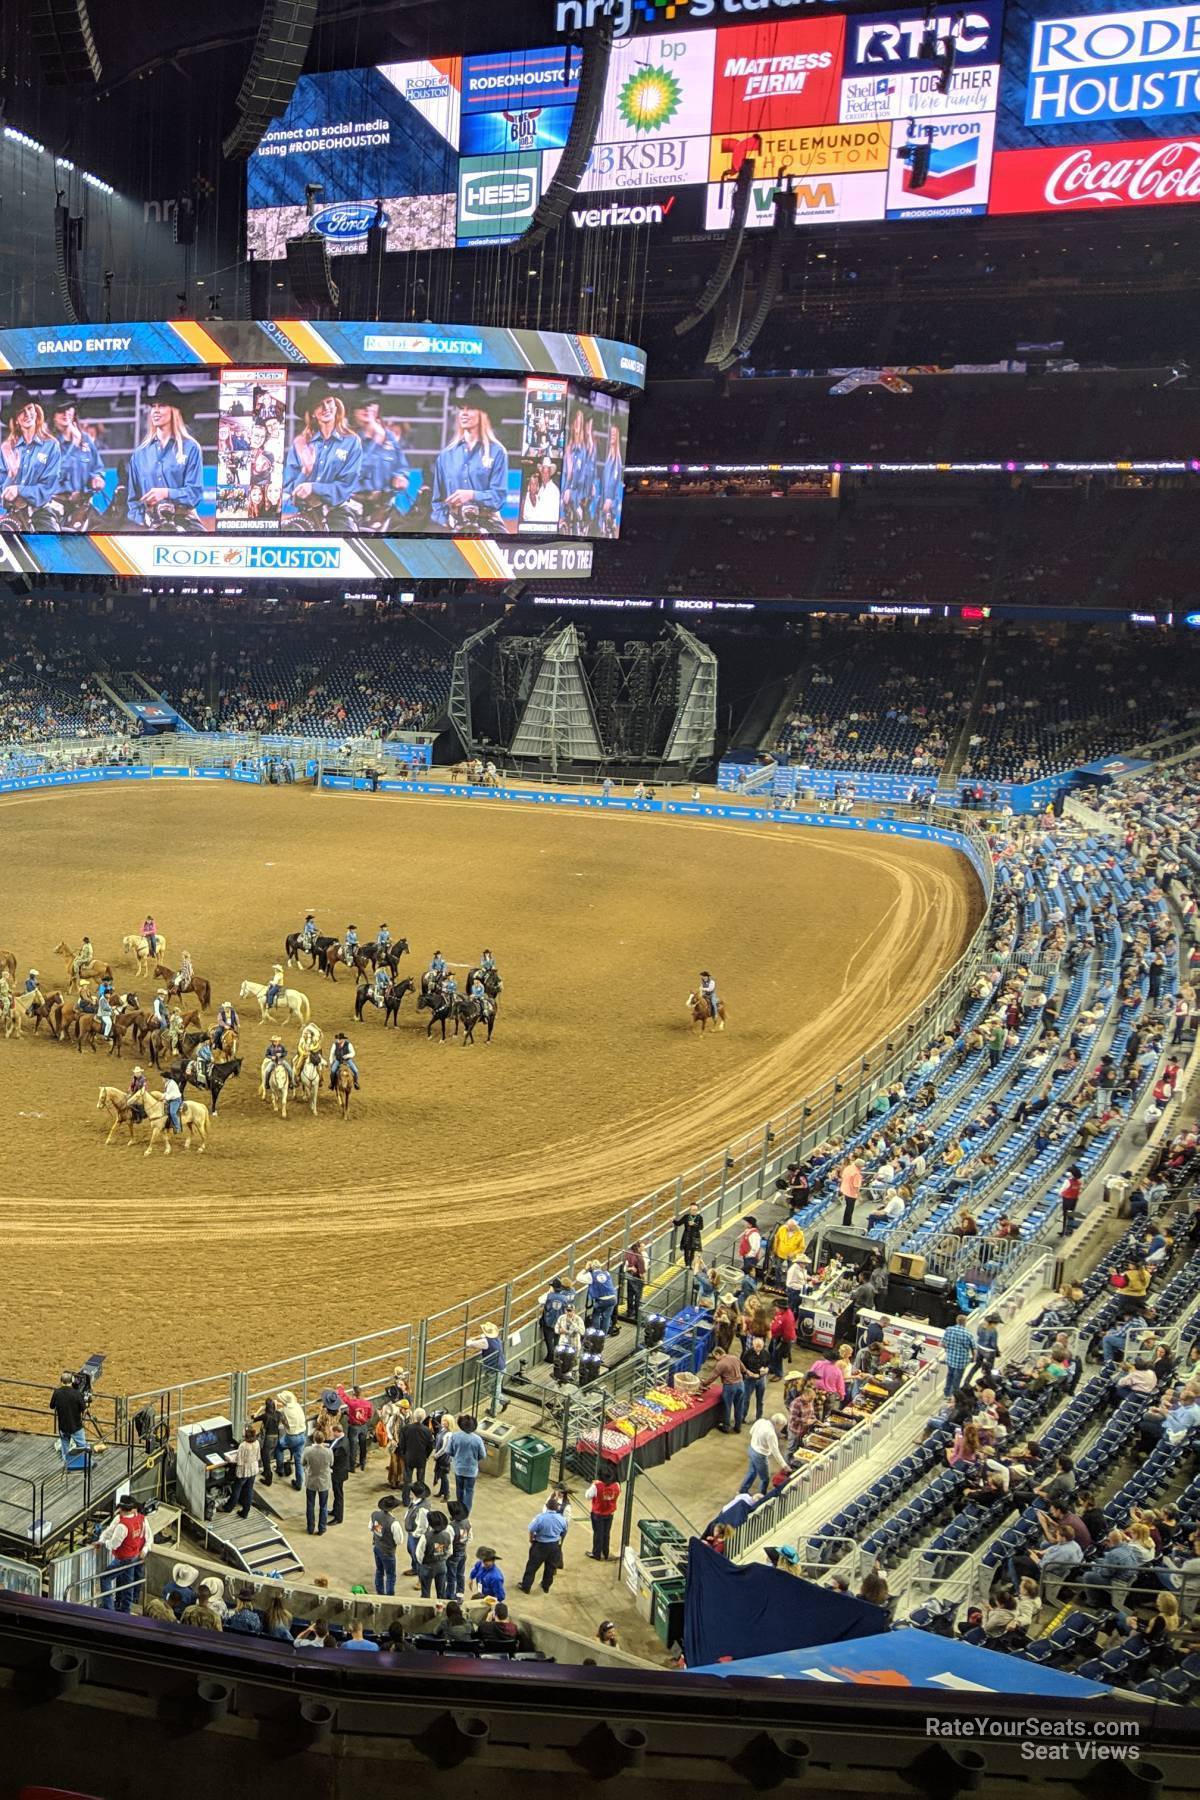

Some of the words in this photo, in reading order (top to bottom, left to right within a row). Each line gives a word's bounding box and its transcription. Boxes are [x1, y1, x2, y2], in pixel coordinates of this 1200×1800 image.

[660, 39, 686, 60] bp
[857, 15, 991, 63] RTIC
[724, 51, 832, 77] MATTRESS
[745, 72, 806, 94] FIRM
[847, 82, 875, 99] Shell
[911, 70, 992, 94] TOGTHER
[407, 87, 449, 99] HOUSTON
[1031, 69, 1200, 120] HOUST
[846, 96, 890, 113] Federal
[306, 128, 319, 137] on
[322, 122, 352, 136] social
[355, 119, 389, 132] media
[511, 120, 536, 142] BULL
[906, 122, 981, 138] Chevron
[259, 144, 287, 157] using
[289, 133, 390, 153] #RODEOHOUSTON
[765, 132, 880, 152] TELEMUNDO
[616, 141, 688, 171] KSBJ
[763, 148, 879, 169] HOUSTON
[616, 173, 641, 187] God
[467, 183, 530, 206] HESS
[328, 211, 370, 232] Ford
[572, 203, 662, 228] verizon
[37, 340, 82, 353] GRAND
[86, 338, 131, 352] ENTRY
[427, 338, 482, 353] HOUSTON
[249, 547, 340, 567] HOUSTON
[560, 549, 575, 570] TO
[589, 599, 624, 607] Technology
[675, 600, 712, 609] RICOH
[902, 606, 931, 614] Contest
[1131, 614, 1155, 622] Trams
